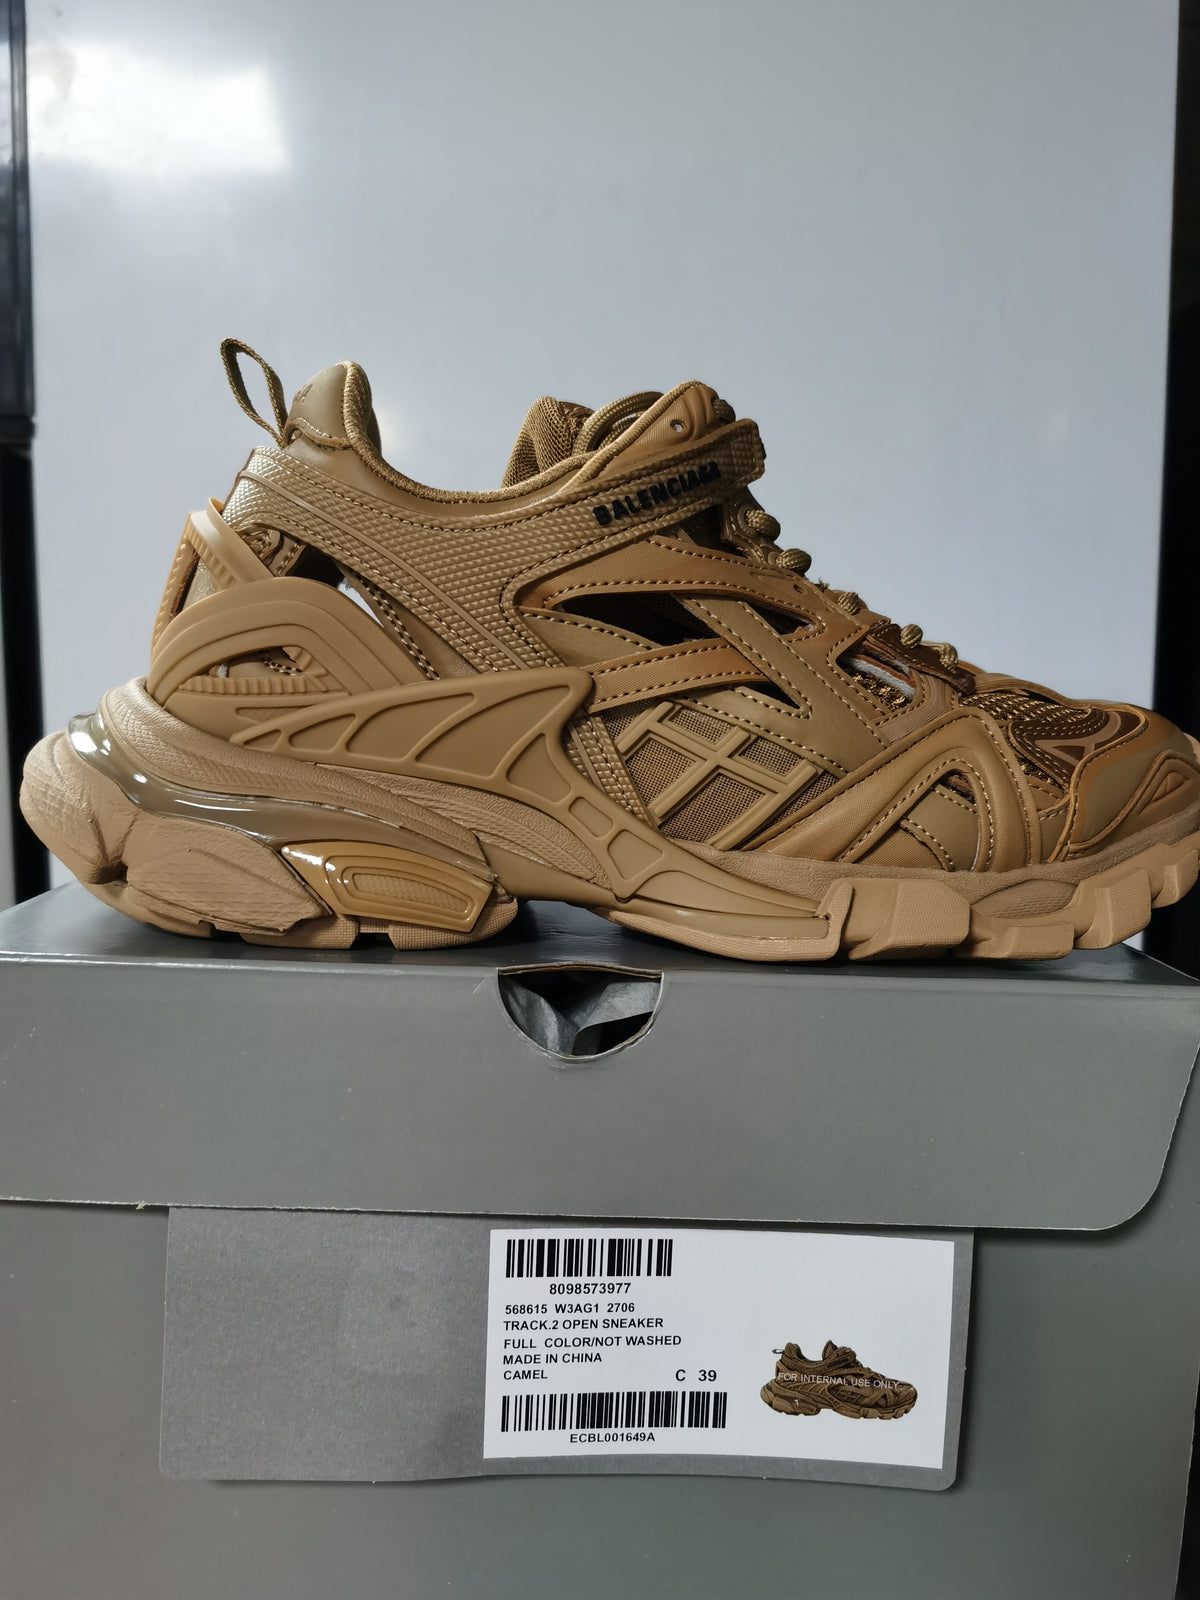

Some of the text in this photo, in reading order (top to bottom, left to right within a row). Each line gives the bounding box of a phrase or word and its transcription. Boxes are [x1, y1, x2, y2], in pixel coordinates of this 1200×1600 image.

[593, 461, 720, 526] BALENCIAGA
[550, 1283, 631, 1294] 8098573977
[506, 1303, 634, 1314] 568615 W3AG1 2706
[504, 1318, 663, 1330] TRACK.2 OPEN SNEAKER
[504, 1336, 681, 1349] FULL COLOR/NOT WASHED
[503, 1353, 602, 1364] MADE IN CHINA
[504, 1370, 547, 1380] CAMEL
[676, 1369, 716, 1381] C 39
[778, 1373, 797, 1381] FOR
[801, 1374, 848, 1385] INTERNAL
[851, 1378, 870, 1387] USE
[570, 1432, 655, 1443] ECBL001649A
